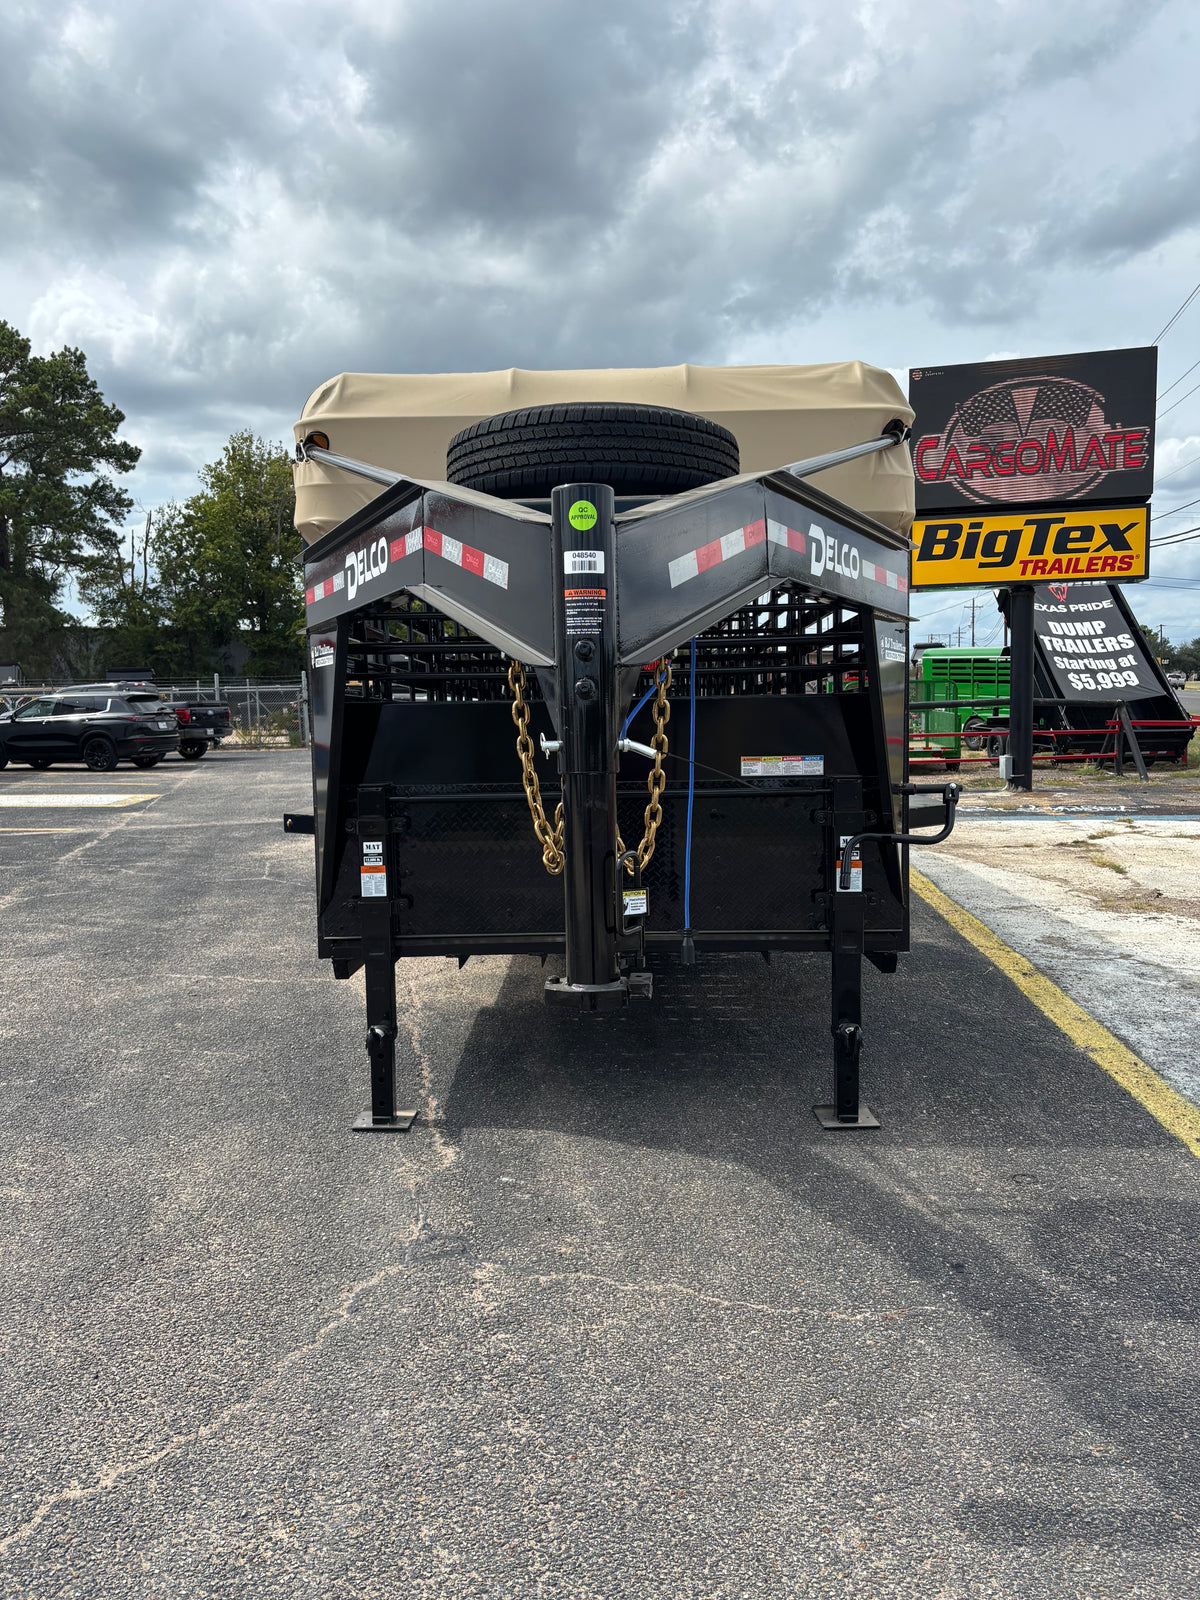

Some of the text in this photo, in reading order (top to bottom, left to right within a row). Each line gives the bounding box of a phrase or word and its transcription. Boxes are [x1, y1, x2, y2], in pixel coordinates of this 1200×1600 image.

[914, 427, 1149, 482] CARGOMATE
[808, 523, 860, 580] DELCO
[345, 536, 388, 600] DELCO
[1019, 555, 1134, 577] TRAILERS
[1034, 598, 1114, 613] EXAS PRIDE
[1047, 620, 1107, 636] DUMP
[1039, 633, 1135, 654] TRAILERS
[1053, 654, 1138, 671] Starting at
[1067, 670, 1140, 691] $5,999
